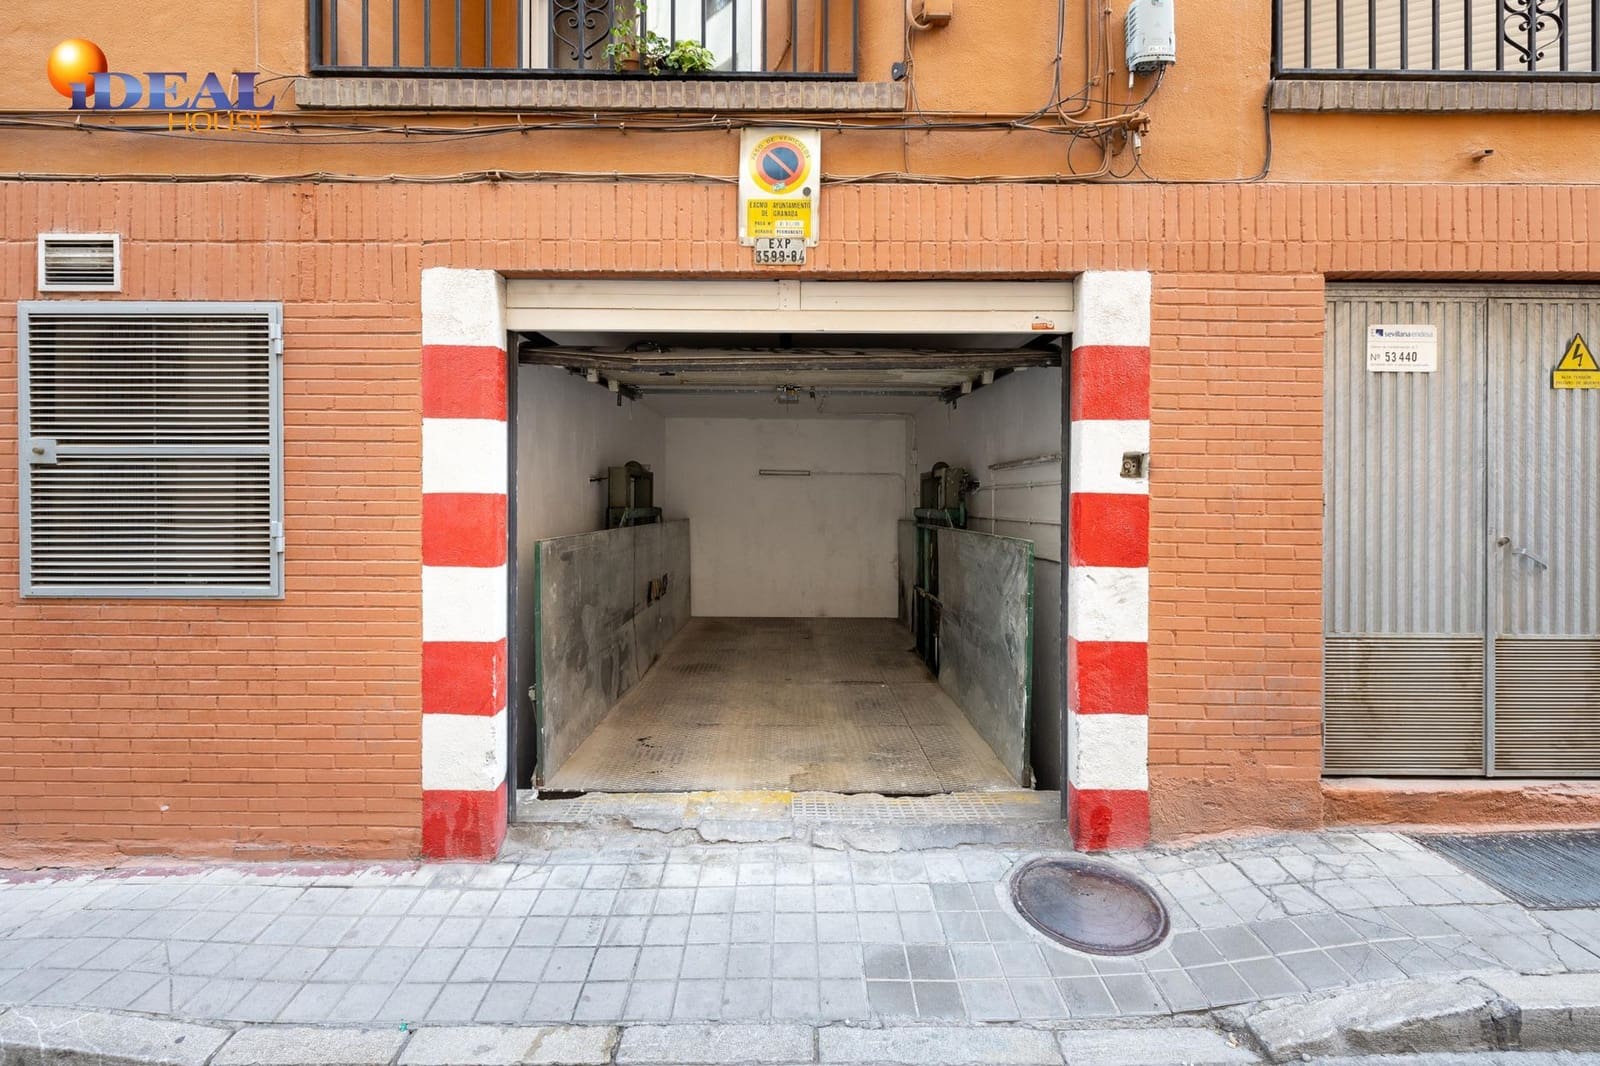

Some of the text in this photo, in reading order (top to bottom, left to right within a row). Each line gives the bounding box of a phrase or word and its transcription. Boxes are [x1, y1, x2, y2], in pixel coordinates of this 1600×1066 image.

[772, 201, 811, 209] AYUNTAMIENTO
[769, 238, 791, 249] EXP
[756, 250, 805, 263] 3599-84
